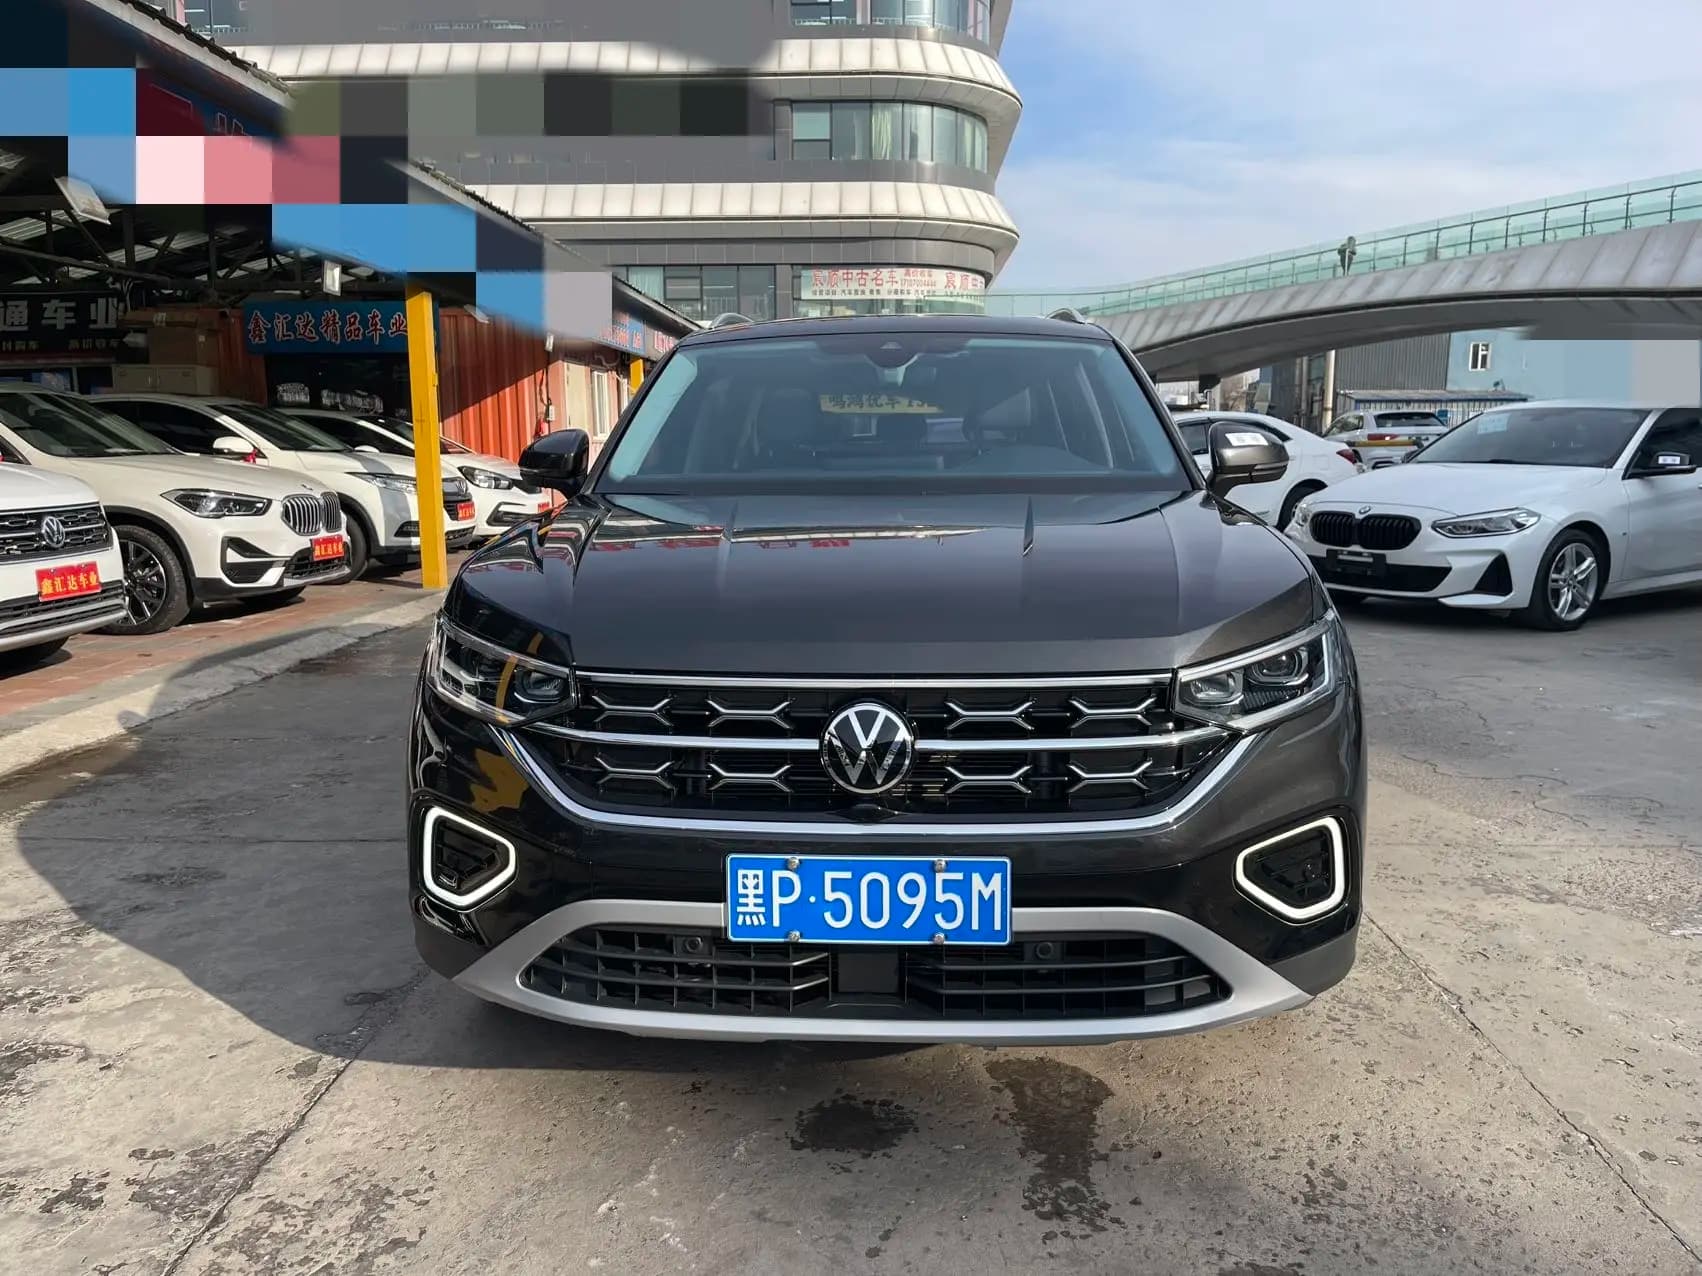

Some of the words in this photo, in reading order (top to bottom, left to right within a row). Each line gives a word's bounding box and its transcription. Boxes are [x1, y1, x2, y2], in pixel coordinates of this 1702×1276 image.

[247, 309, 409, 345] 鑫汇达精品车业
